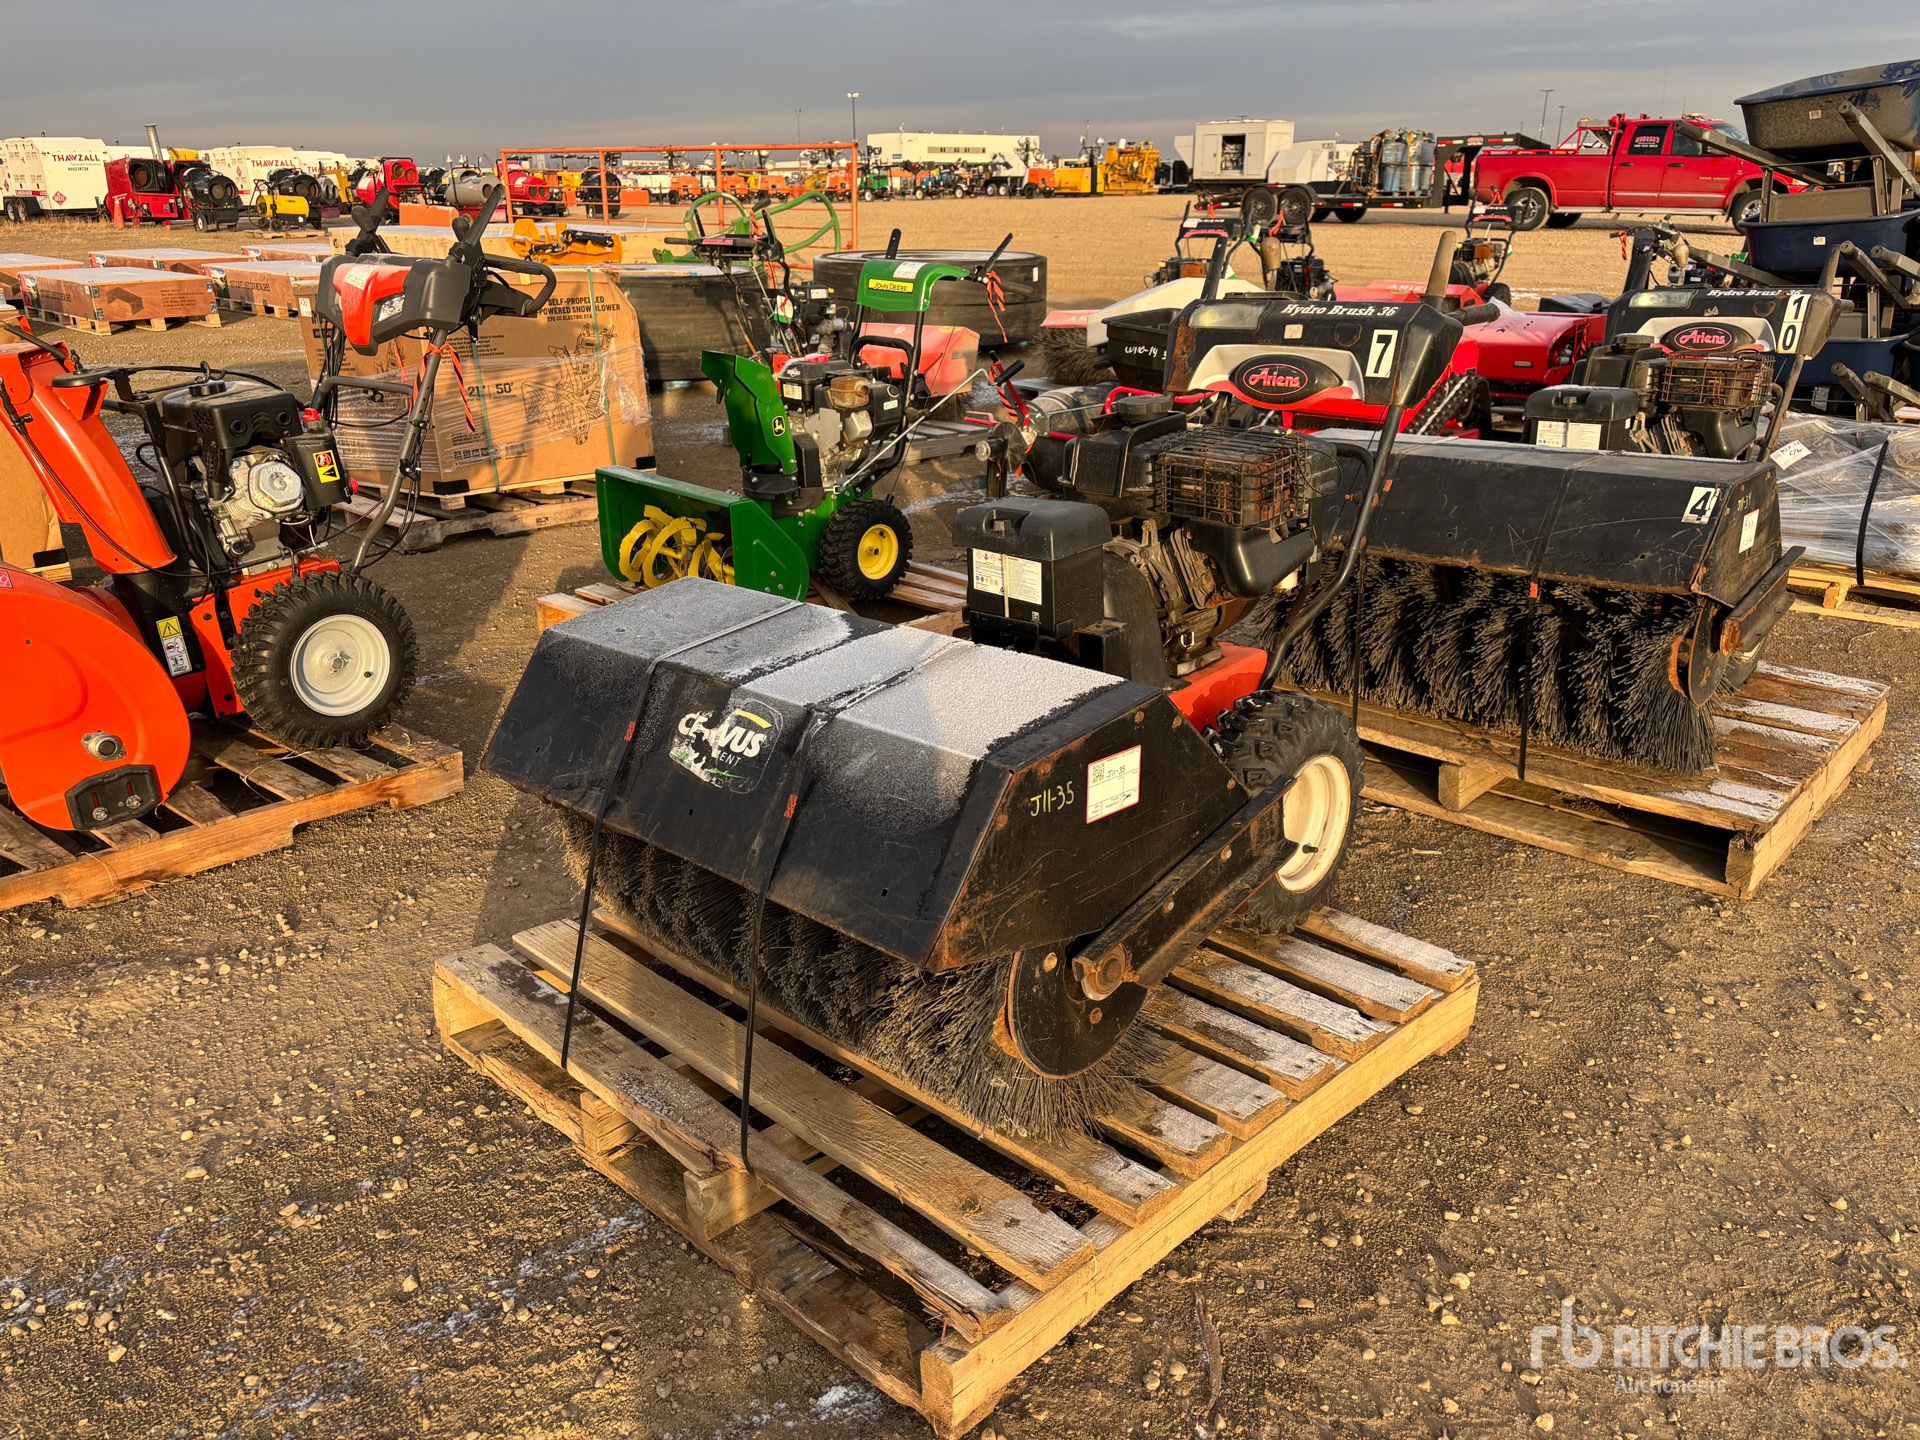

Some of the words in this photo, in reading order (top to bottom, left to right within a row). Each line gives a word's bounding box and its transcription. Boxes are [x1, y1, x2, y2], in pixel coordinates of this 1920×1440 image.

[52, 154, 100, 162] THAWZALL
[251, 159, 294, 167] THAWZALL
[874, 281, 888, 290] JOHN
[889, 283, 908, 291] DEERE
[1707, 289, 1744, 298] Hydro
[572, 305, 592, 314] SNOW
[1281, 303, 1327, 316] Hydro
[1327, 305, 1376, 317] Brush
[1376, 306, 1399, 317] 36
[1680, 329, 1725, 345] Ariens
[1373, 334, 1393, 374] 7
[1249, 367, 1301, 388] Ariens
[1688, 491, 1713, 521] 4
[1030, 780, 1075, 817] J11-35
